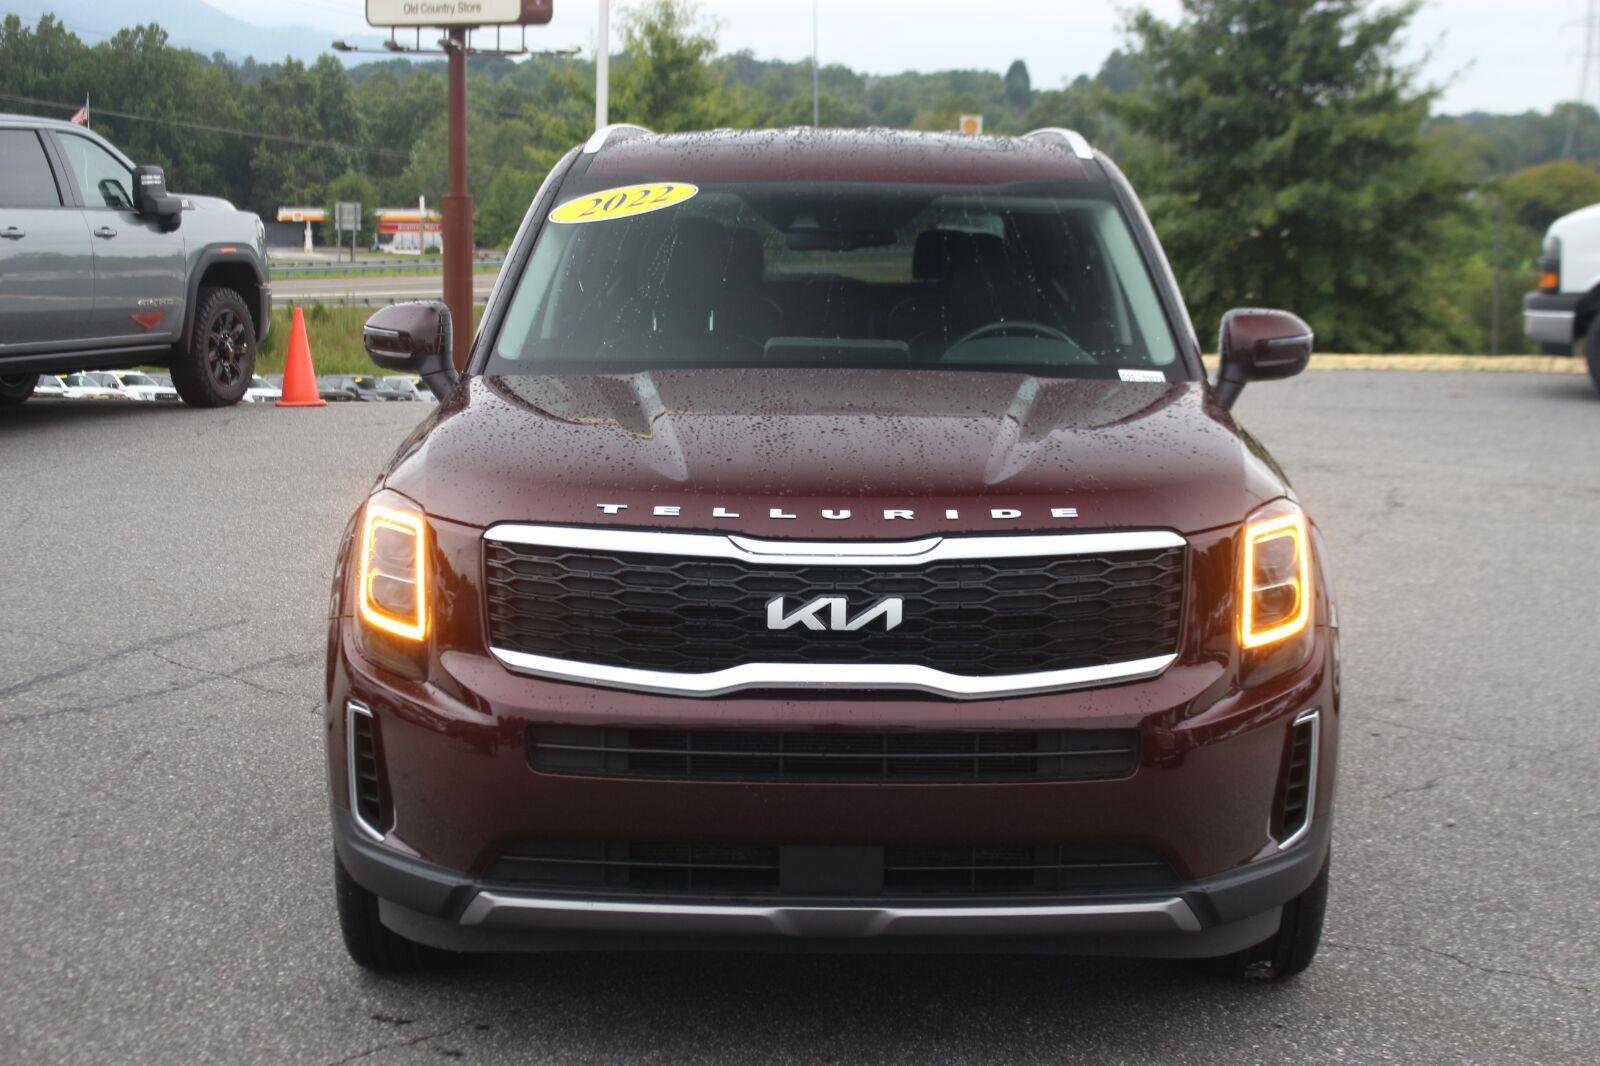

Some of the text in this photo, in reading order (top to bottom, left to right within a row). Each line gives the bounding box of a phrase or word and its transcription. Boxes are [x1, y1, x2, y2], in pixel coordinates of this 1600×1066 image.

[403, 1, 481, 17] Old Country Store
[577, 186, 675, 218] 2022
[596, 503, 1079, 520] TELLURIDE
[766, 595, 904, 632] KIA
